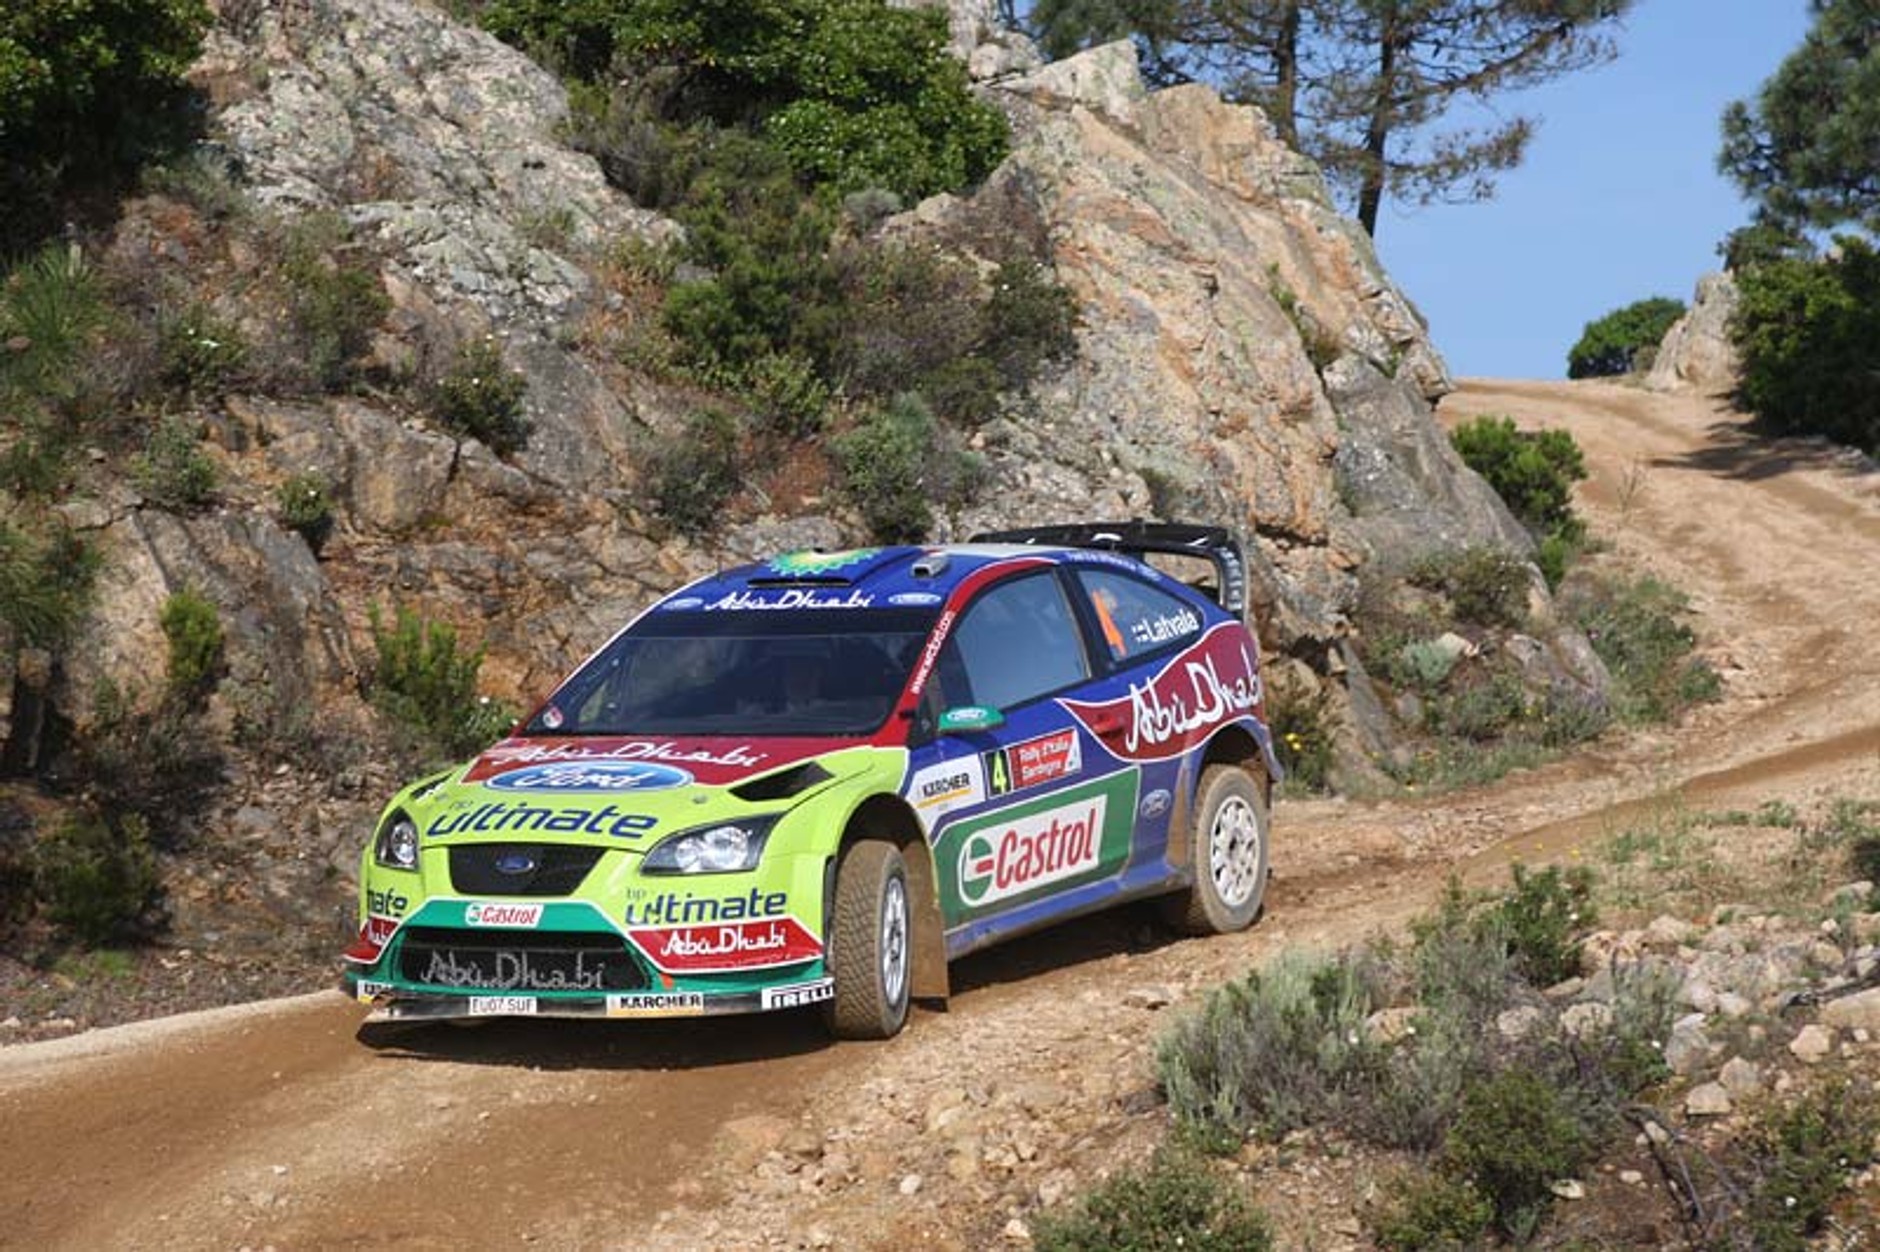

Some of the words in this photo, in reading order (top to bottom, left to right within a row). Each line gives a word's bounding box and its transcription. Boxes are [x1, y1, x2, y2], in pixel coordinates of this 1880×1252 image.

[704, 591, 768, 610] Abu
[776, 589, 875, 609] Dhabi
[1125, 676, 1191, 752] Abu
[492, 744, 592, 766] Abu
[606, 741, 767, 767] Dhabi
[992, 750, 1008, 795] 4
[513, 766, 656, 787] Ford
[426, 802, 659, 839] ultimate
[995, 807, 1097, 890] Castrol
[482, 906, 538, 924] Castrol
[625, 887, 787, 925] ultimate
[660, 929, 711, 957] Abu
[719, 922, 786, 953] Dhabi
[420, 950, 483, 987] Abu
[495, 950, 606, 990] Dhabi
